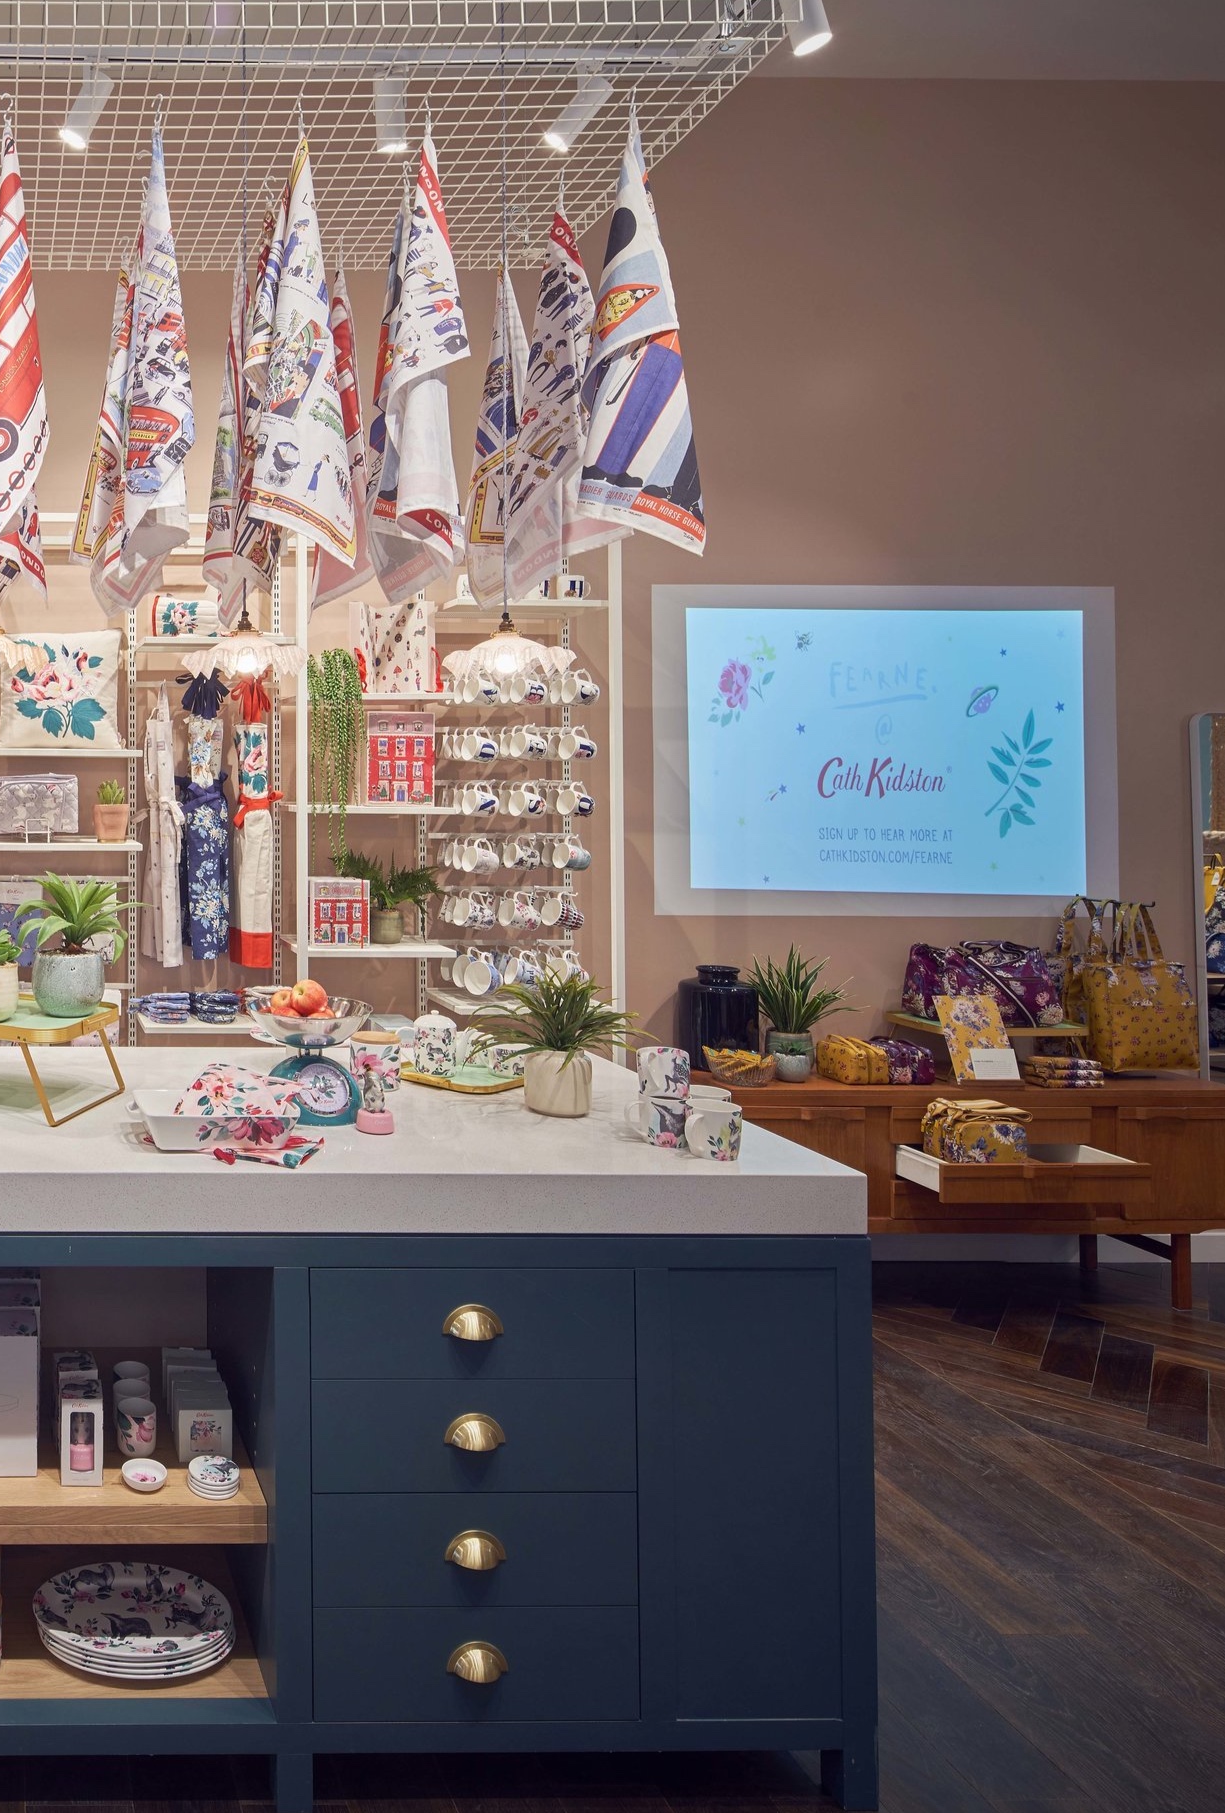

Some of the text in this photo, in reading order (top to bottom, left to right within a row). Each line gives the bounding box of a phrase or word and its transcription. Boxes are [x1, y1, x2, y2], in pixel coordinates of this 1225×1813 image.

[635, 496, 657, 511] ROYAL
[658, 505, 681, 522] HORSE
[682, 517, 706, 537] GUARDS
[817, 757, 863, 798] Cath
[819, 827, 953, 841] SIGN UP TO HEAR MORE AT
[819, 849, 953, 864] CATHKIDSTON.COM/FEARNE
